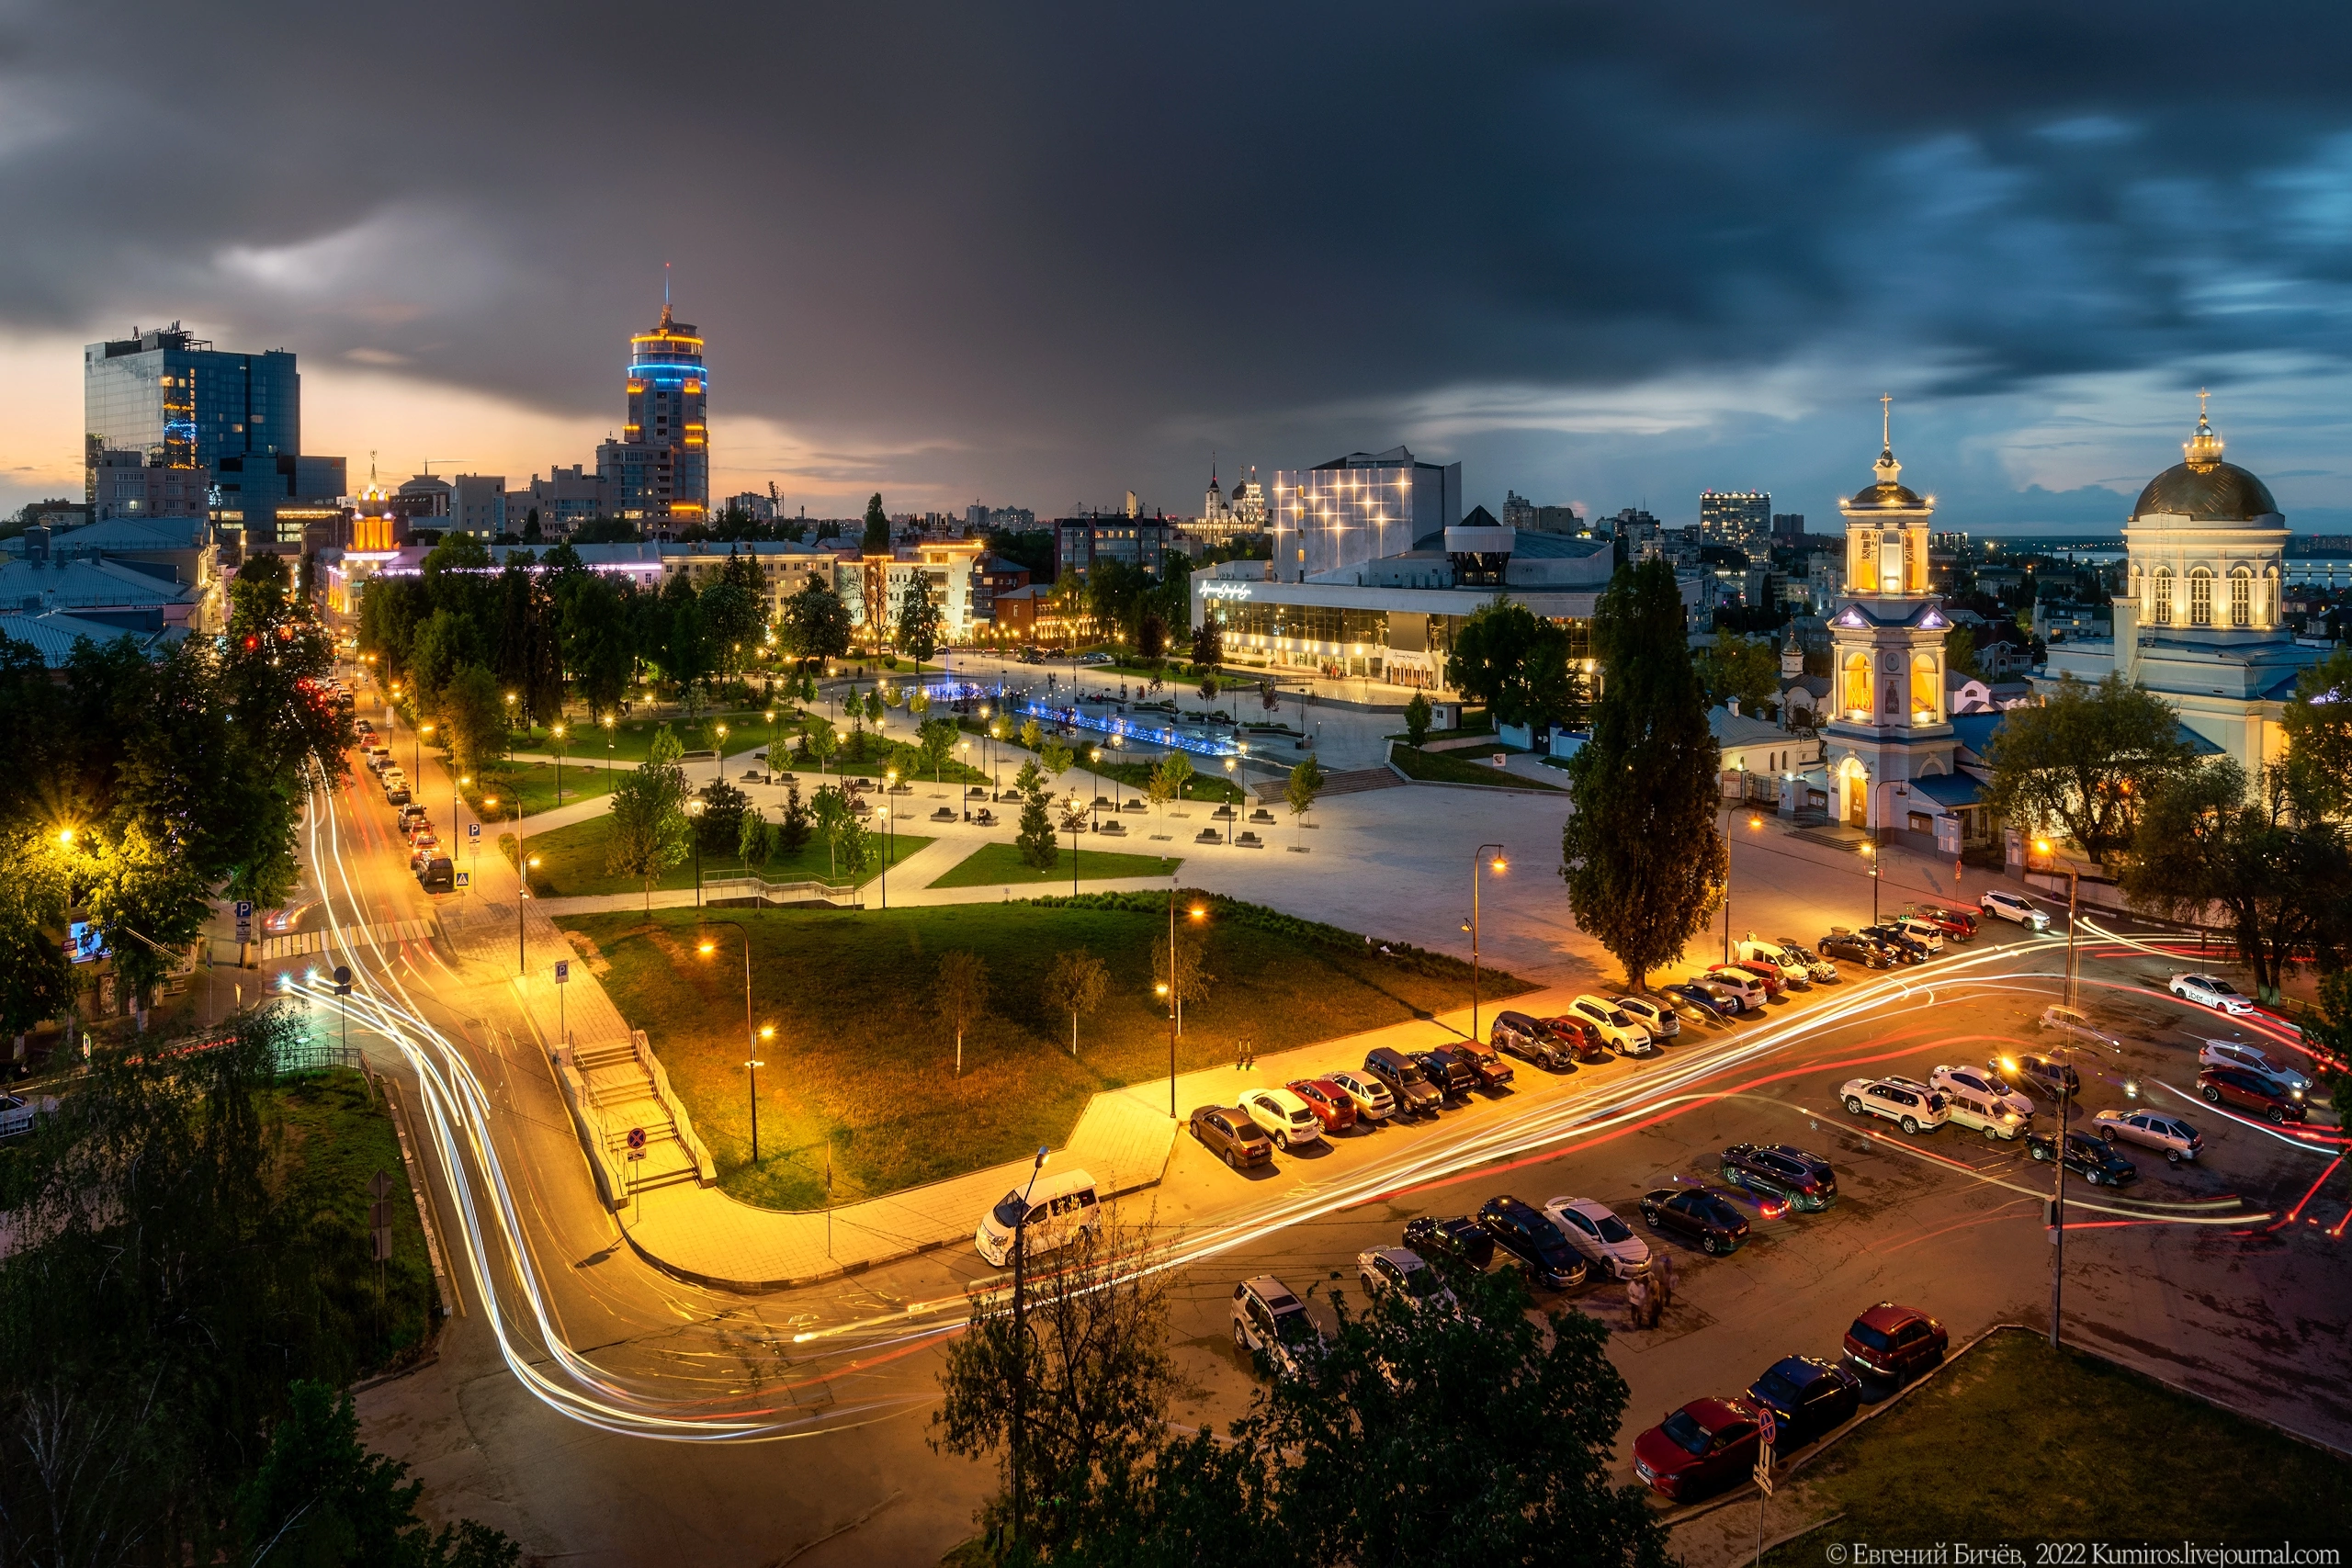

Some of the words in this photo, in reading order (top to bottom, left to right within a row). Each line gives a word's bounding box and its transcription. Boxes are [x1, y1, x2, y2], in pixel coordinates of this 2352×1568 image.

[471, 824, 479, 835] P
[240, 903, 249, 917] P
[559, 965, 565, 976] P
[2185, 988, 2203, 1002] Uber
